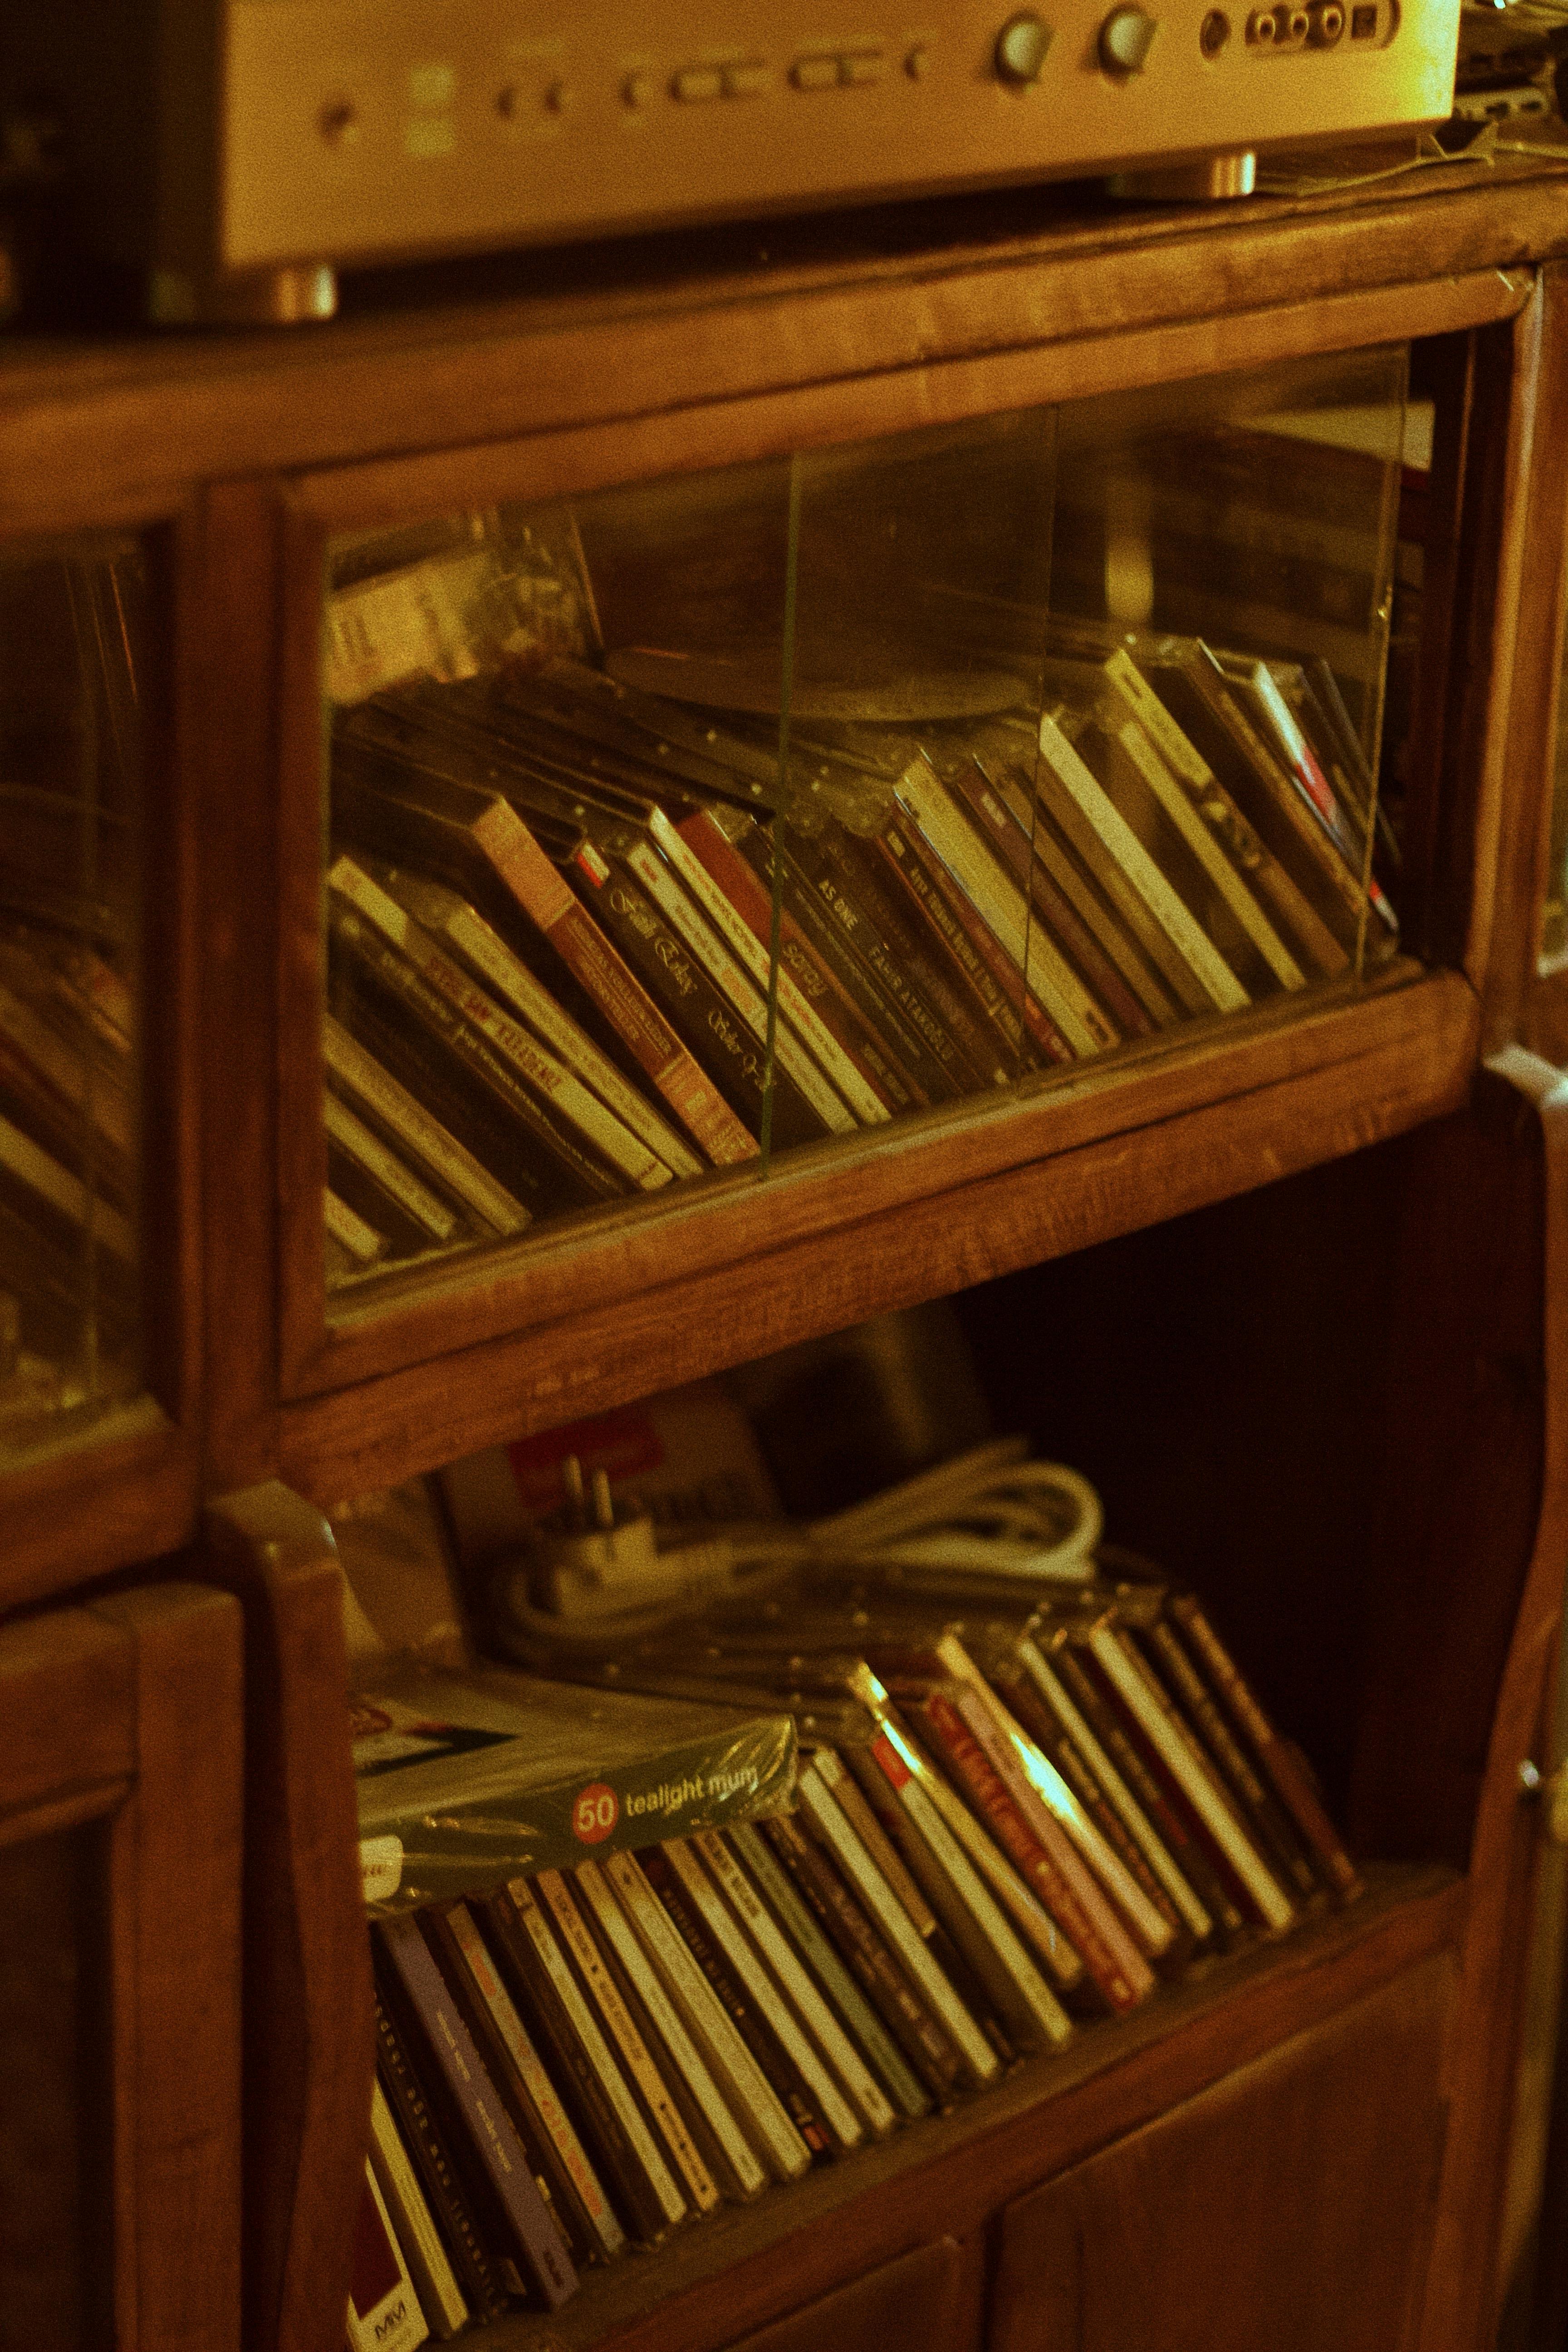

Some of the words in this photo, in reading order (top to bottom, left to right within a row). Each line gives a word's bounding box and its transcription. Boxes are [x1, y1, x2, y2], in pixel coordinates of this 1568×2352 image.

[818, 879, 837, 901] AS
[834, 898, 858, 931] ONE
[578, 1793, 615, 1833] 50
[625, 1775, 705, 1817] tealight
